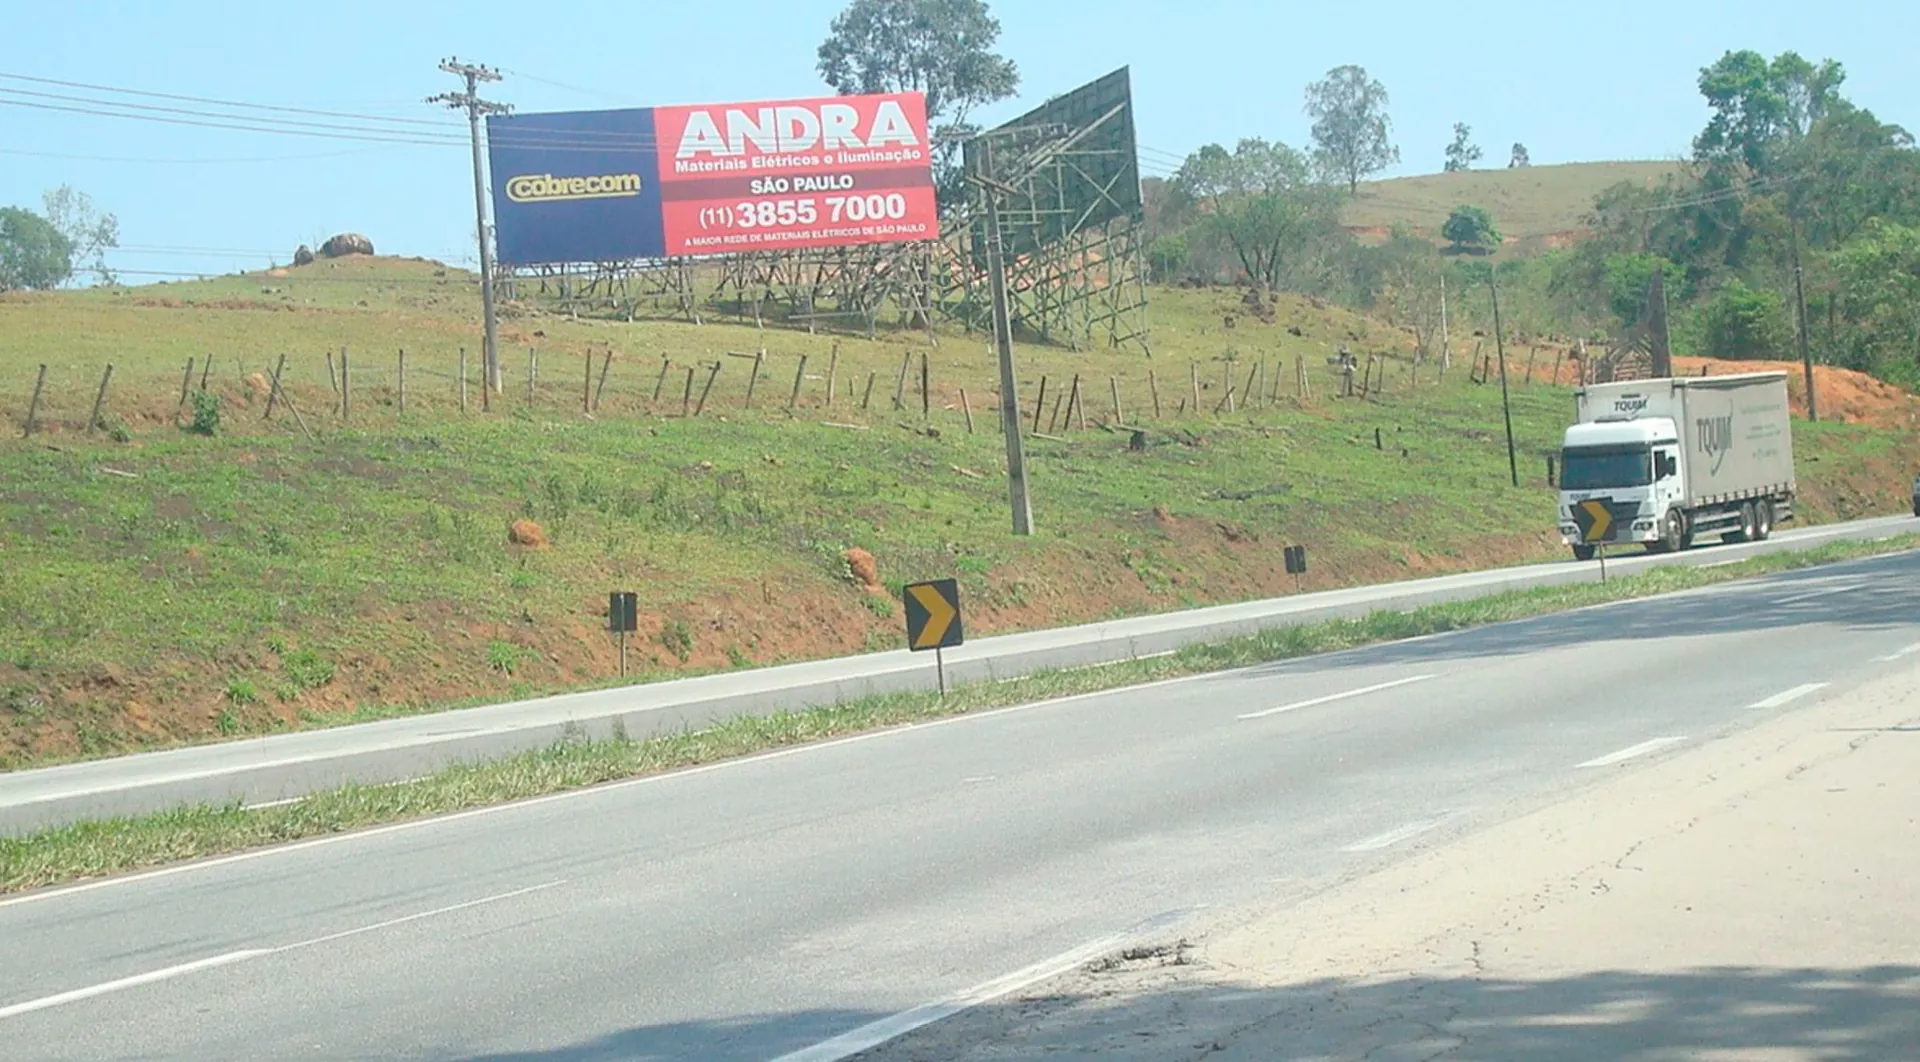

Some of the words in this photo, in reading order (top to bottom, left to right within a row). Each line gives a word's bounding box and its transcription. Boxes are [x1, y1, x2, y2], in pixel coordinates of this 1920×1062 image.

[675, 100, 920, 158] ANDRA
[675, 159, 748, 174] Materiais
[751, 154, 820, 169] Elétricos
[823, 153, 834, 165] e
[508, 173, 641, 202] cobrecom
[750, 177, 791, 195] SÃO
[793, 174, 854, 192] PAULO
[699, 206, 734, 230] (11)
[736, 199, 818, 229] 3855
[825, 193, 906, 223] 7000
[685, 238, 692, 246] A
[692, 235, 722, 246] MAIOR
[723, 233, 749, 244] REDE
[749, 232, 763, 242] DE
[763, 230, 811, 242] MATERIAIS
[812, 226, 861, 239] ELÉTRICOS
[862, 225, 875, 236] DE
[876, 223, 895, 235] SÃO
[896, 222, 926, 234] PAULO
[1696, 416, 1733, 458] TQUIM
